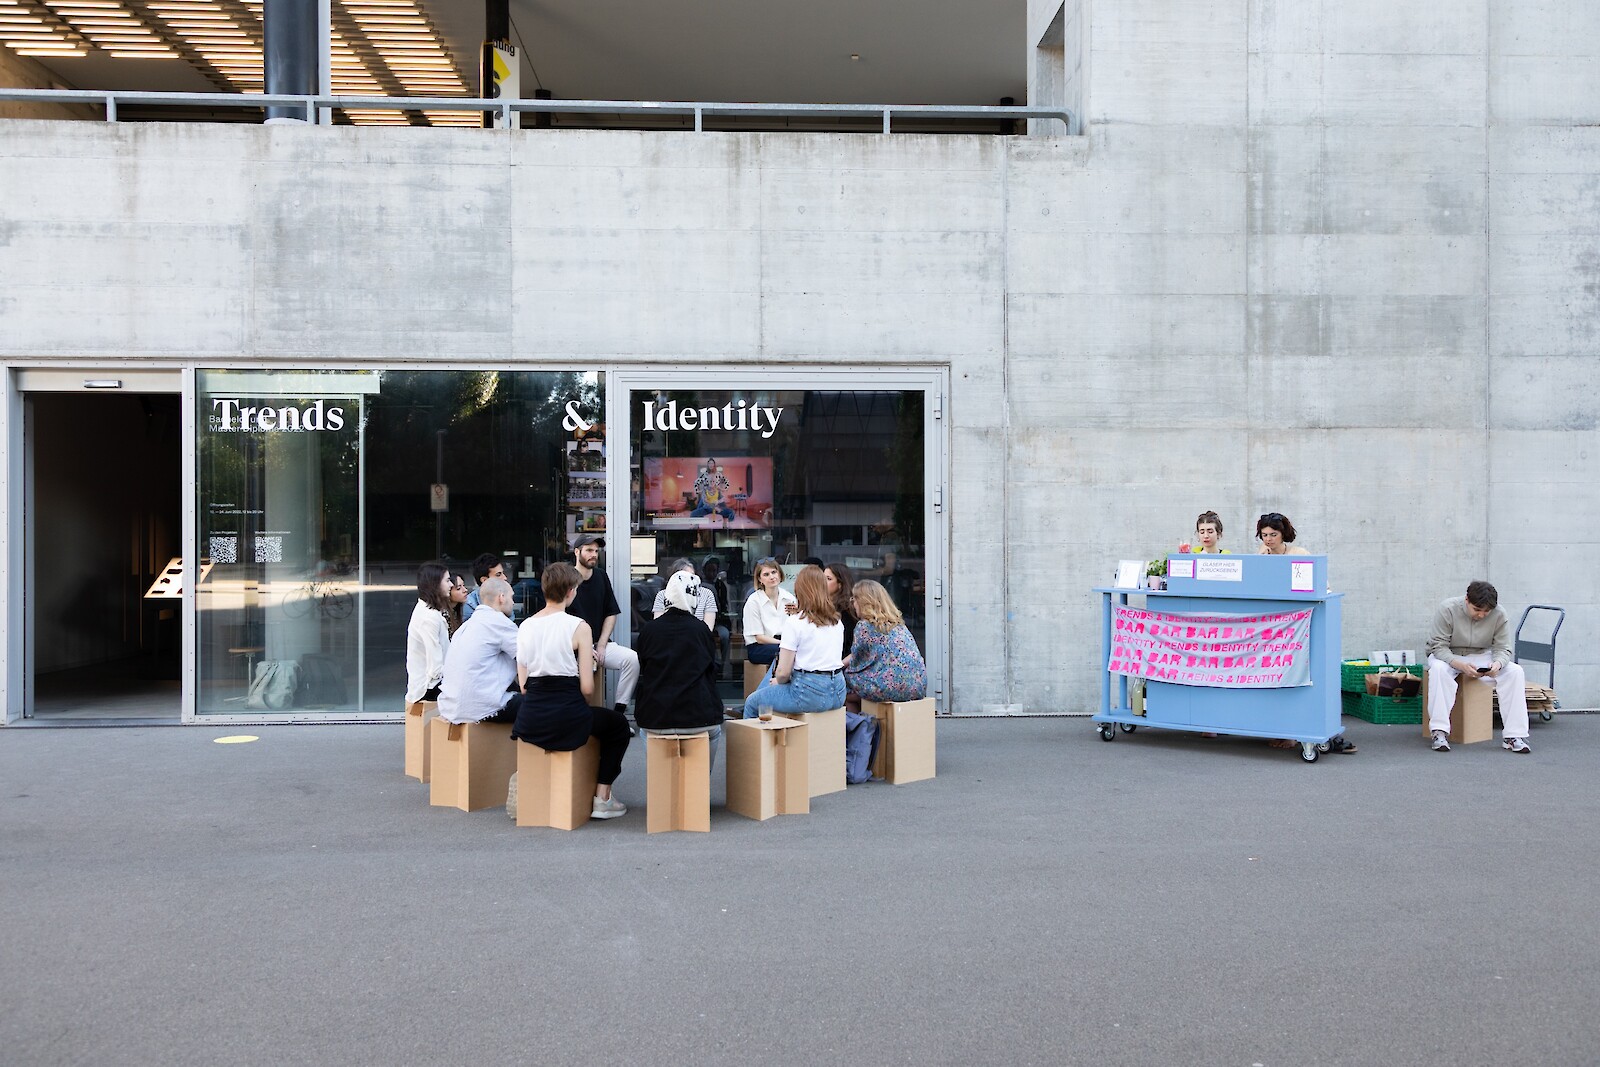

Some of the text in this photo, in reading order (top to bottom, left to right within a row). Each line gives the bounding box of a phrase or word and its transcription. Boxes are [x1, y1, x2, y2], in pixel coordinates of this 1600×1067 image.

[213, 399, 784, 439] Trends & Identity
[1115, 608, 1153, 620] TRENDS
[1115, 619, 1295, 640] BAR BAR BAR BAR BAR
[1113, 634, 1303, 652] IDENTITY TRENDS & IDENTITY TRENDS
[1113, 646, 1293, 668] BAR BAR BAR BAR BAR
[1109, 660, 1283, 684] BAR BAR TRENDS & IDENTITY
